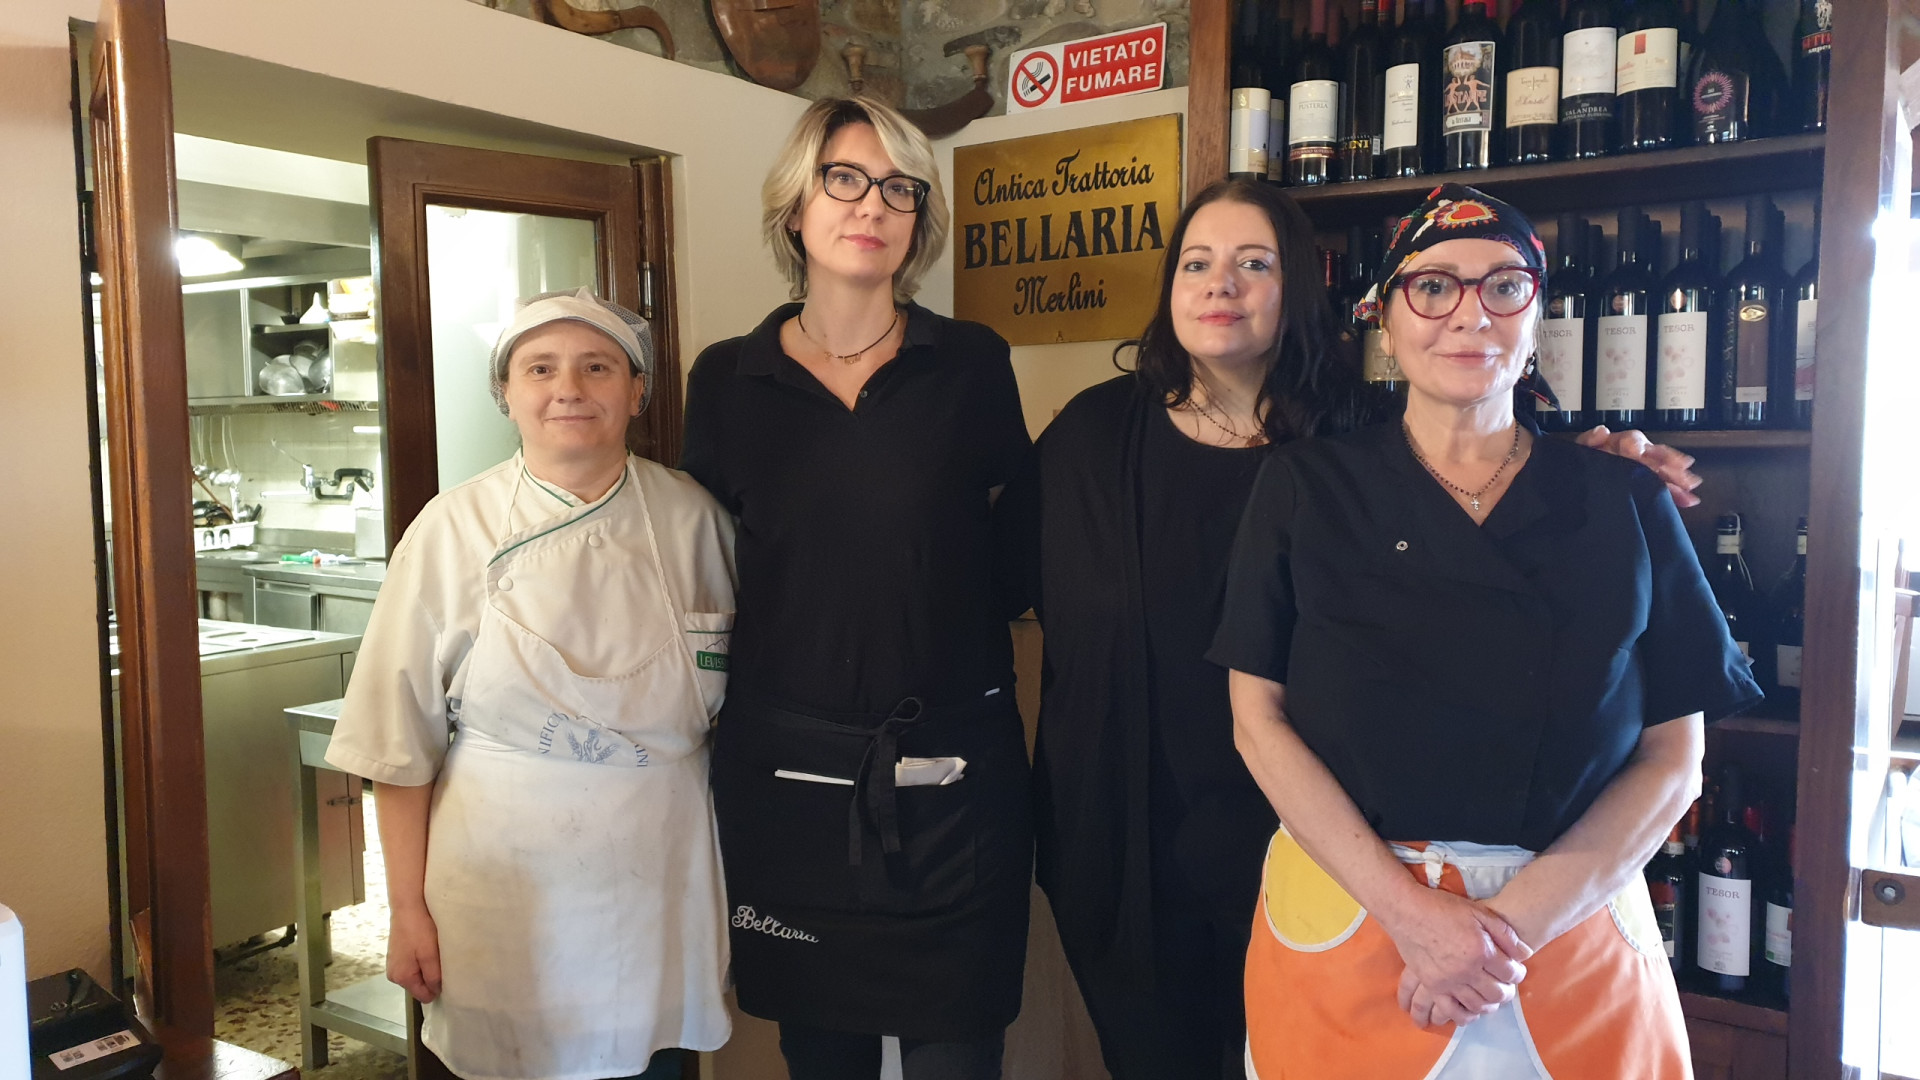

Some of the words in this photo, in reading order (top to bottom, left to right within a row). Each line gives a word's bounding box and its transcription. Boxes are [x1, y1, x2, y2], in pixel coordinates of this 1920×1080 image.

[1069, 37, 1157, 69] VIETATO
[1066, 62, 1157, 94] FUMARE
[974, 168, 1048, 206] Antica
[1052, 149, 1154, 195] Trattoria
[963, 201, 1165, 270] BELLARIA
[1013, 272, 1107, 315] Merlini
[1605, 326, 1637, 336] TESOR
[1664, 323, 1695, 333] TESOR
[1706, 886, 1740, 899] TESOR
[731, 905, 820, 943] Bellaria
